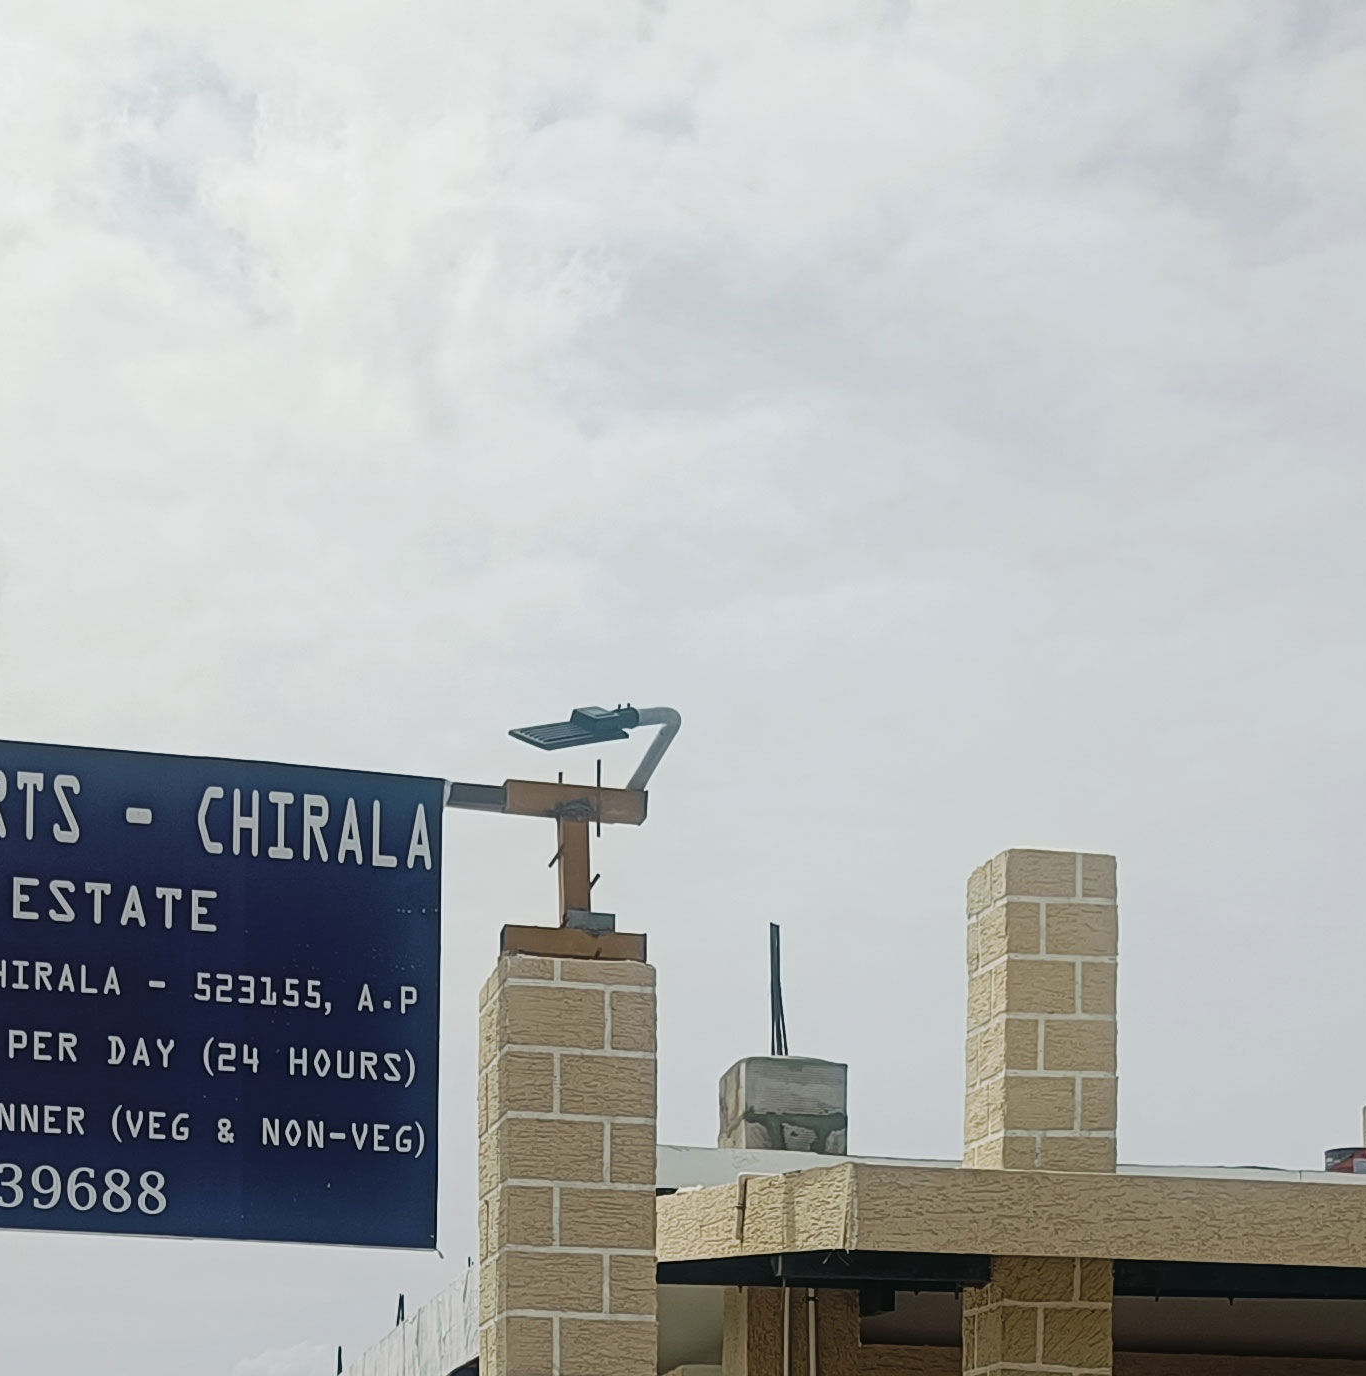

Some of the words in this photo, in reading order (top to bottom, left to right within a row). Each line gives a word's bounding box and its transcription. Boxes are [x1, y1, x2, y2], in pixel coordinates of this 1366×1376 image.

[126, 807, 152, 824] -
[198, 786, 431, 870] CHIRALA
[13, 877, 217, 932] ESTATE
[149, 980, 165, 988] -
[194, 972, 331, 1015] 523155,
[358, 984, 417, 1014] A.P
[9, 1030, 77, 1062] PER
[108, 1036, 174, 1067] DAY
[204, 1039, 259, 1076] (24
[290, 1047, 415, 1088] HOURS)
[112, 1105, 189, 1143] (VEG
[218, 1118, 234, 1143] &
[263, 1118, 424, 1158] NON-VEG)
